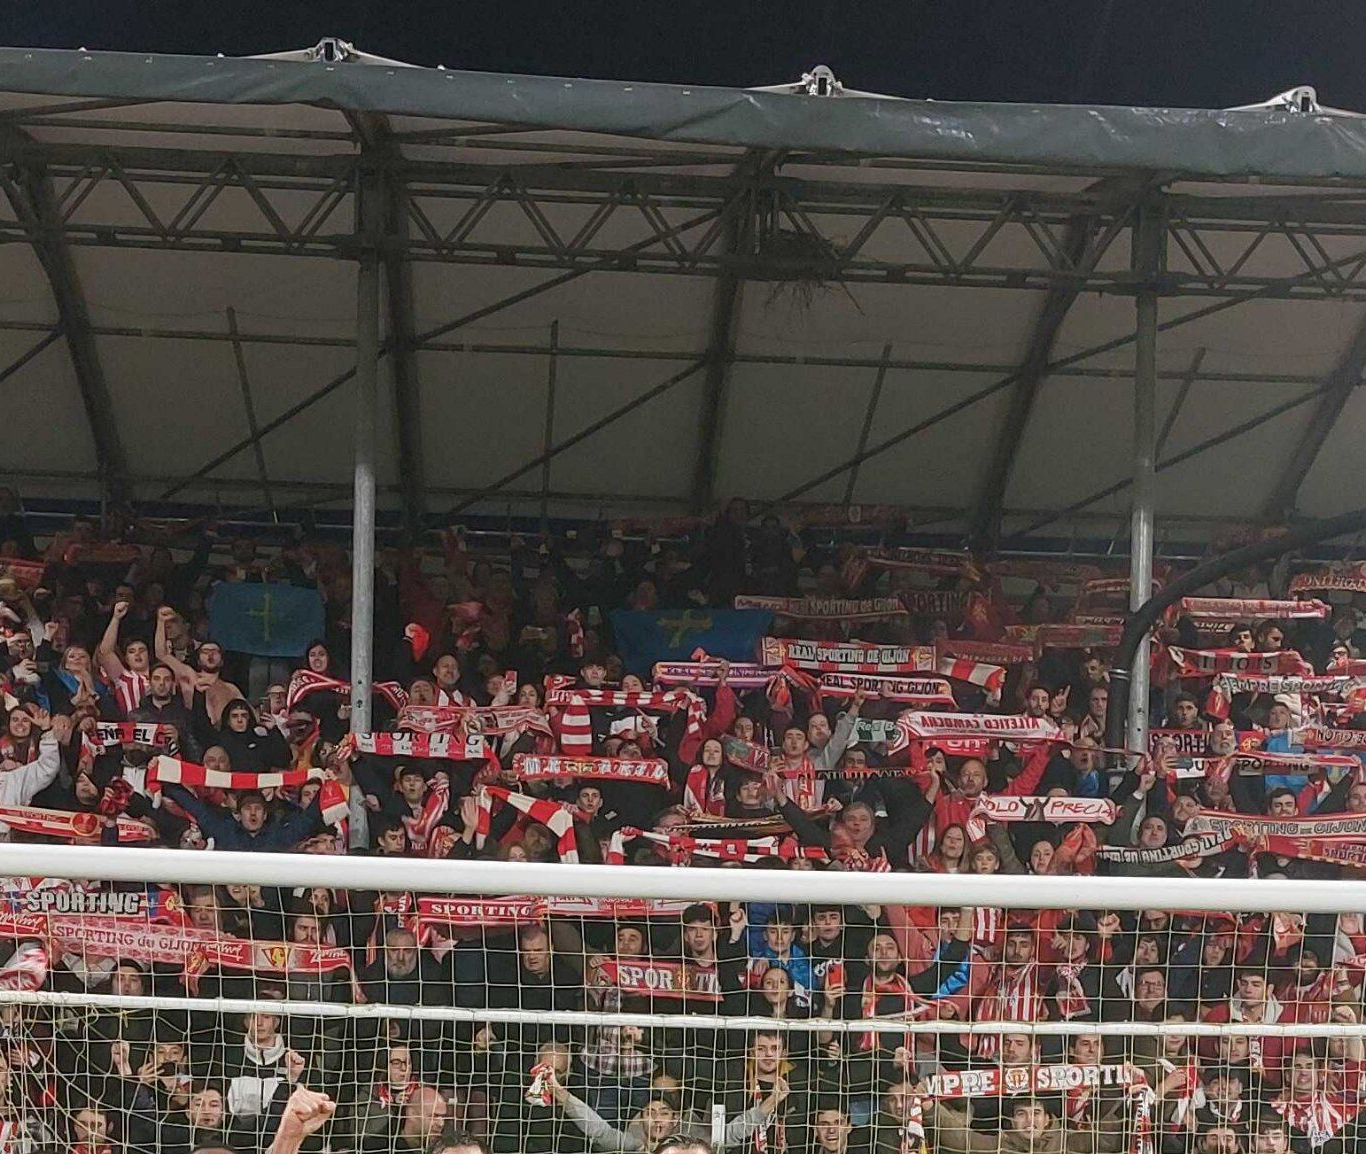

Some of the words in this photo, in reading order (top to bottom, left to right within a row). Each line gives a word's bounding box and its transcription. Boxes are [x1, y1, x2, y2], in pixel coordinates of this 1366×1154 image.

[817, 647, 864, 664] SPORTING
[24, 890, 142, 914] SPORTING
[430, 904, 533, 917] SPORTING
[55, 926, 135, 947] SPORTING
